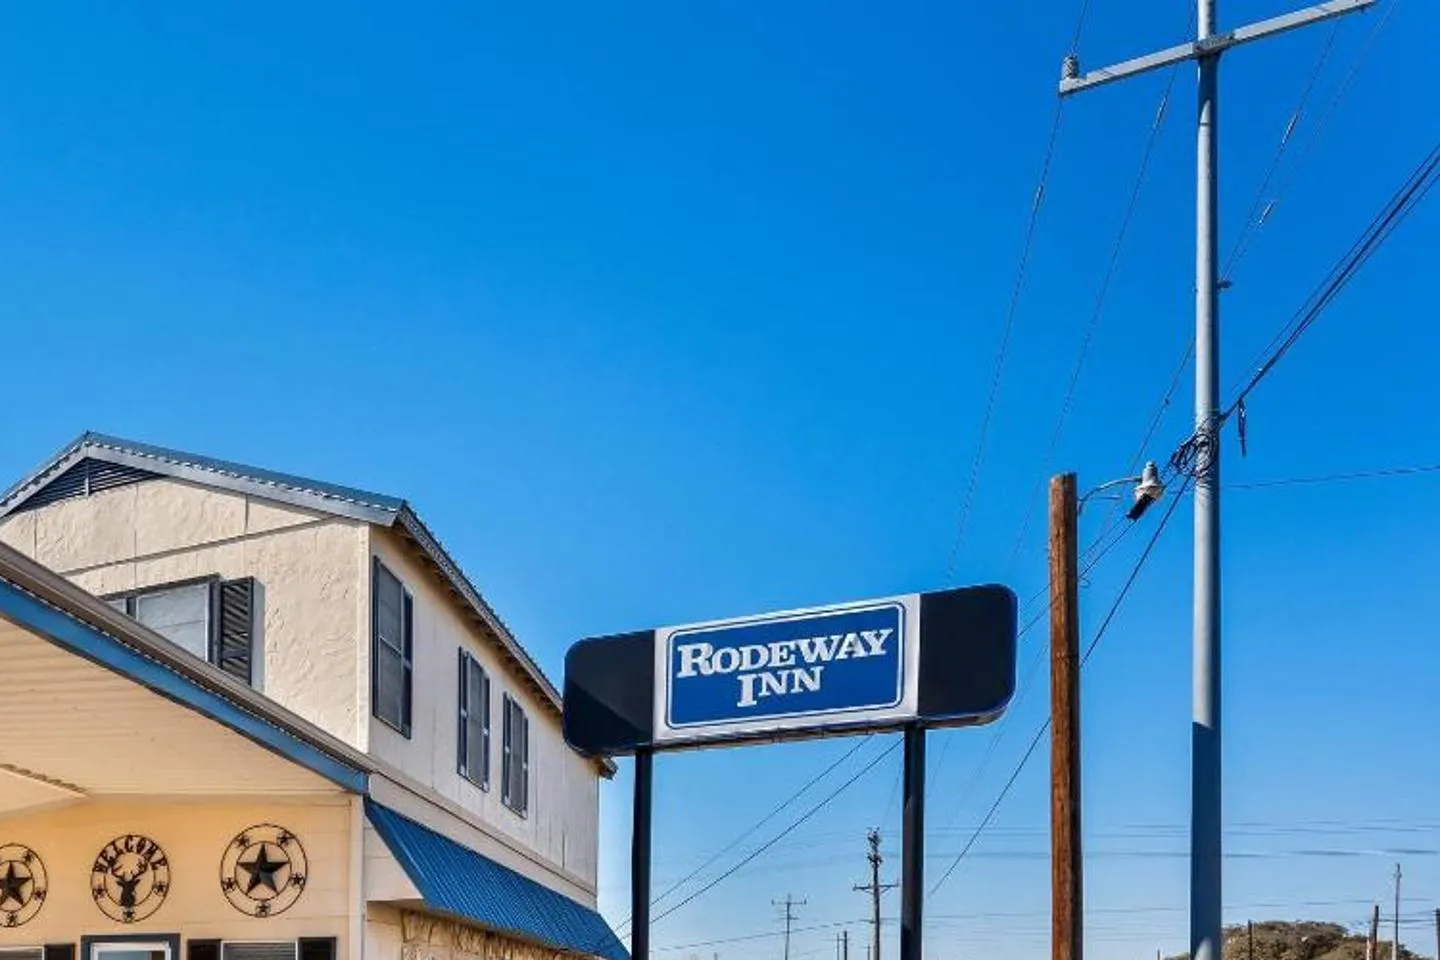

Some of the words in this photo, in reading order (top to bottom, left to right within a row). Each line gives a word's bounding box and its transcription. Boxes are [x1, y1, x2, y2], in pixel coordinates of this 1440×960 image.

[677, 628, 894, 678] RODEWAY
[736, 666, 823, 707] INN
[94, 834, 168, 873] WELCOME
